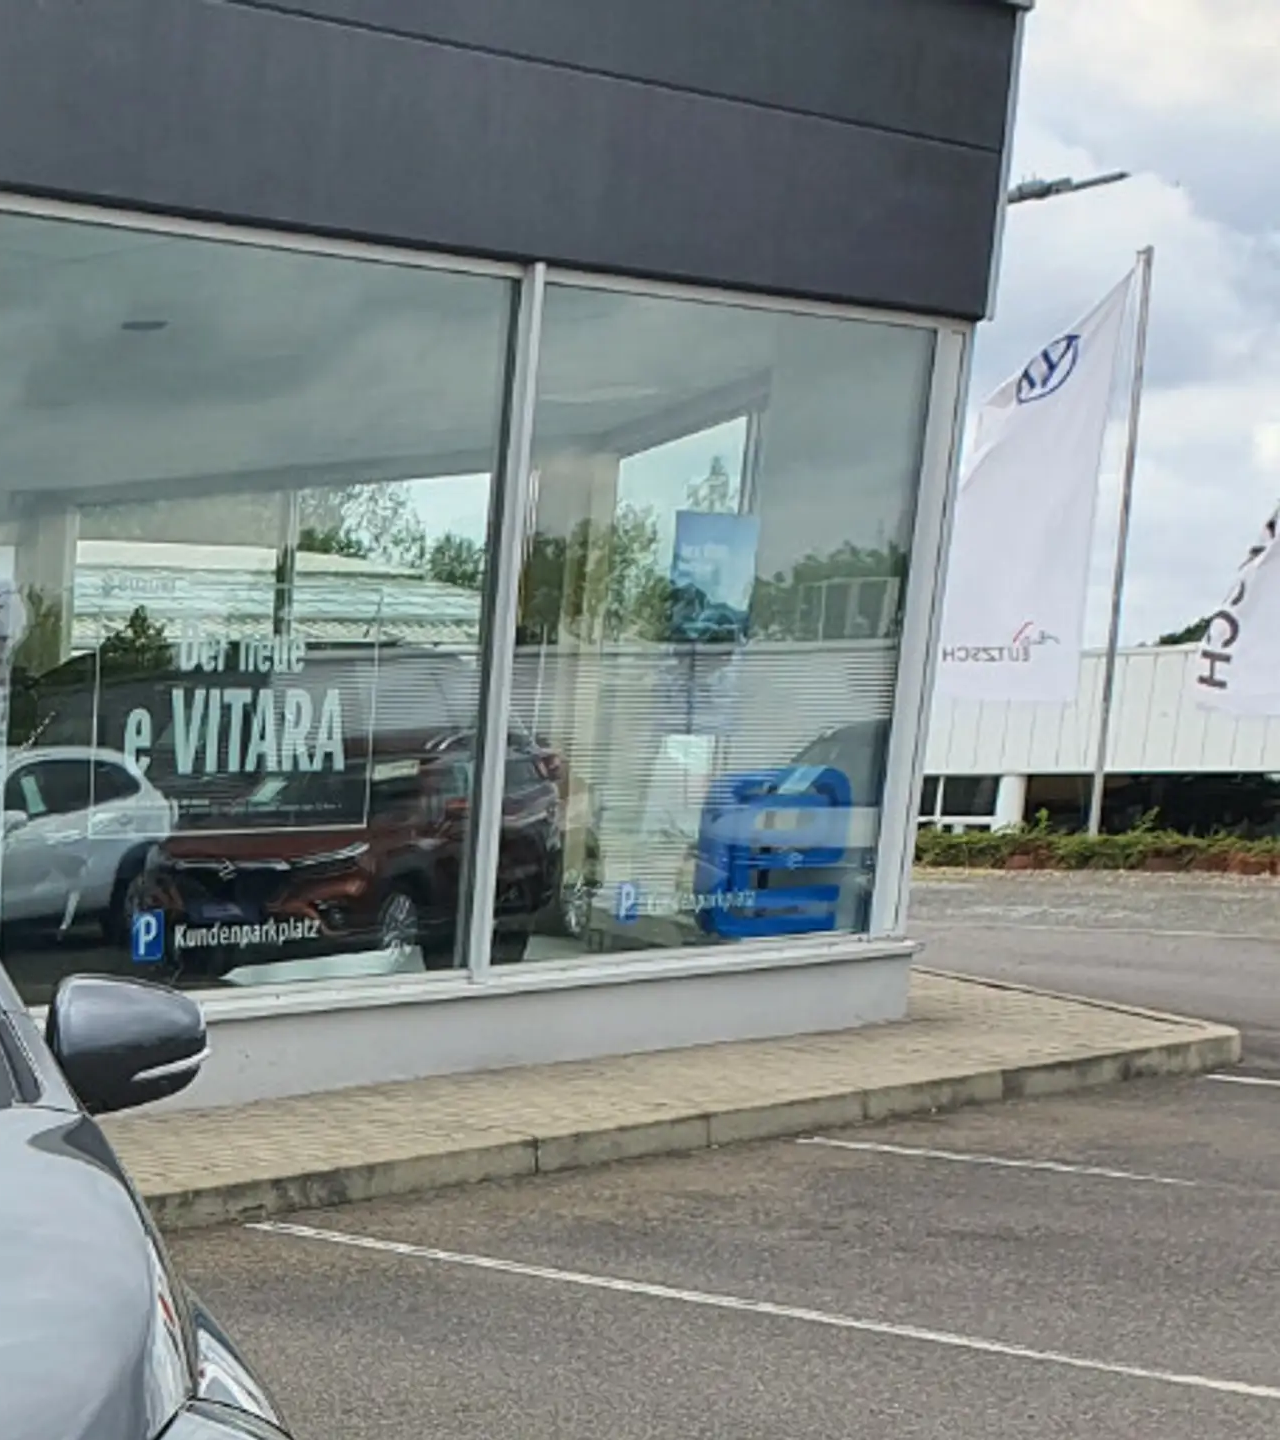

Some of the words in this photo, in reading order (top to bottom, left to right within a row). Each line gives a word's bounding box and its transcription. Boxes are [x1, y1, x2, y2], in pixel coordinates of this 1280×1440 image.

[124, 708, 153, 771] e
[172, 687, 346, 775] VITARA
[174, 917, 321, 949] Kundenparkplatz
